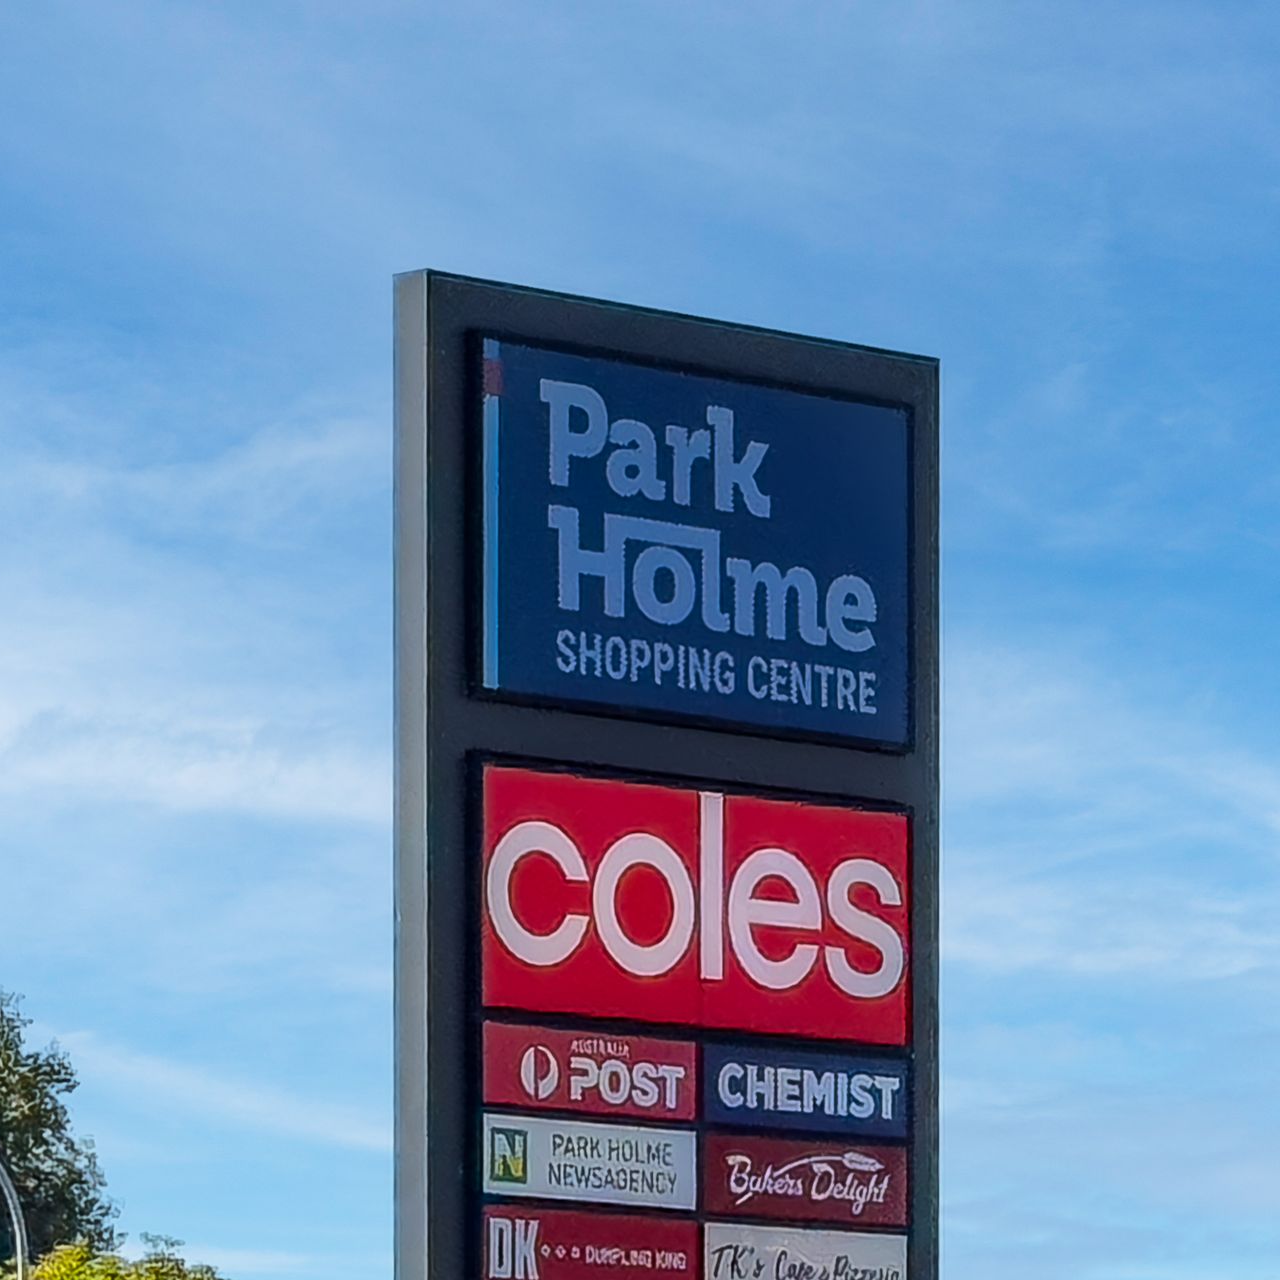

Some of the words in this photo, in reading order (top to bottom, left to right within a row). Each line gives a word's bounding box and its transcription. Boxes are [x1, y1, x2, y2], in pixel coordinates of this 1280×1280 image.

[540, 378, 771, 518] Park
[548, 505, 878, 652] Holme
[556, 629, 735, 694] SHOPPING
[747, 655, 877, 714] CENTRE
[487, 791, 904, 998] coles
[570, 1057, 685, 1109] POST
[718, 1062, 900, 1120] CHEMIST
[548, 1163, 677, 1194] NEWSAGENCY
[552, 1134, 602, 1159] PARK
[608, 1138, 673, 1166] HOLME
[725, 1155, 804, 1198] Bakers
[811, 1163, 891, 1215] Delight
[489, 1217, 539, 1280] DK
[655, 1249, 687, 1270] KING
[711, 1245, 765, 1280] TK's
